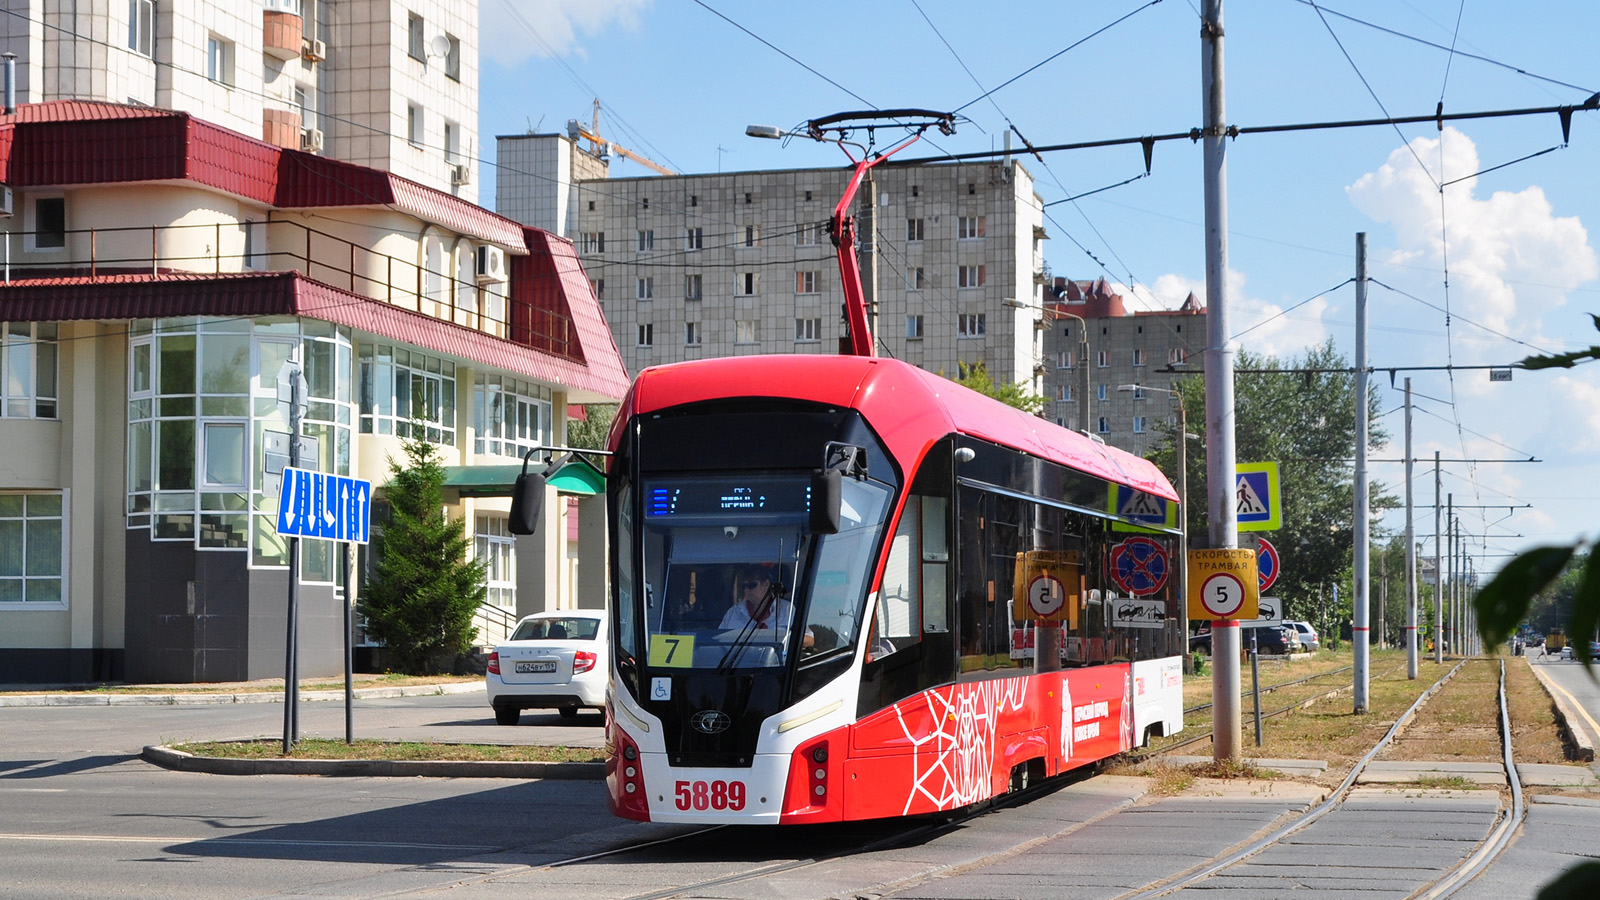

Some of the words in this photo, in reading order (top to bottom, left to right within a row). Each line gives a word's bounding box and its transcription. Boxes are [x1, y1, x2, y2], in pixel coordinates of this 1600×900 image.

[1195, 551, 1249, 559] СКОРОСТЬ
[1197, 562, 1248, 570] ТРАМВАЯ
[1216, 586, 1228, 603] 5
[664, 639, 680, 664] 7
[674, 780, 746, 811] 5889
